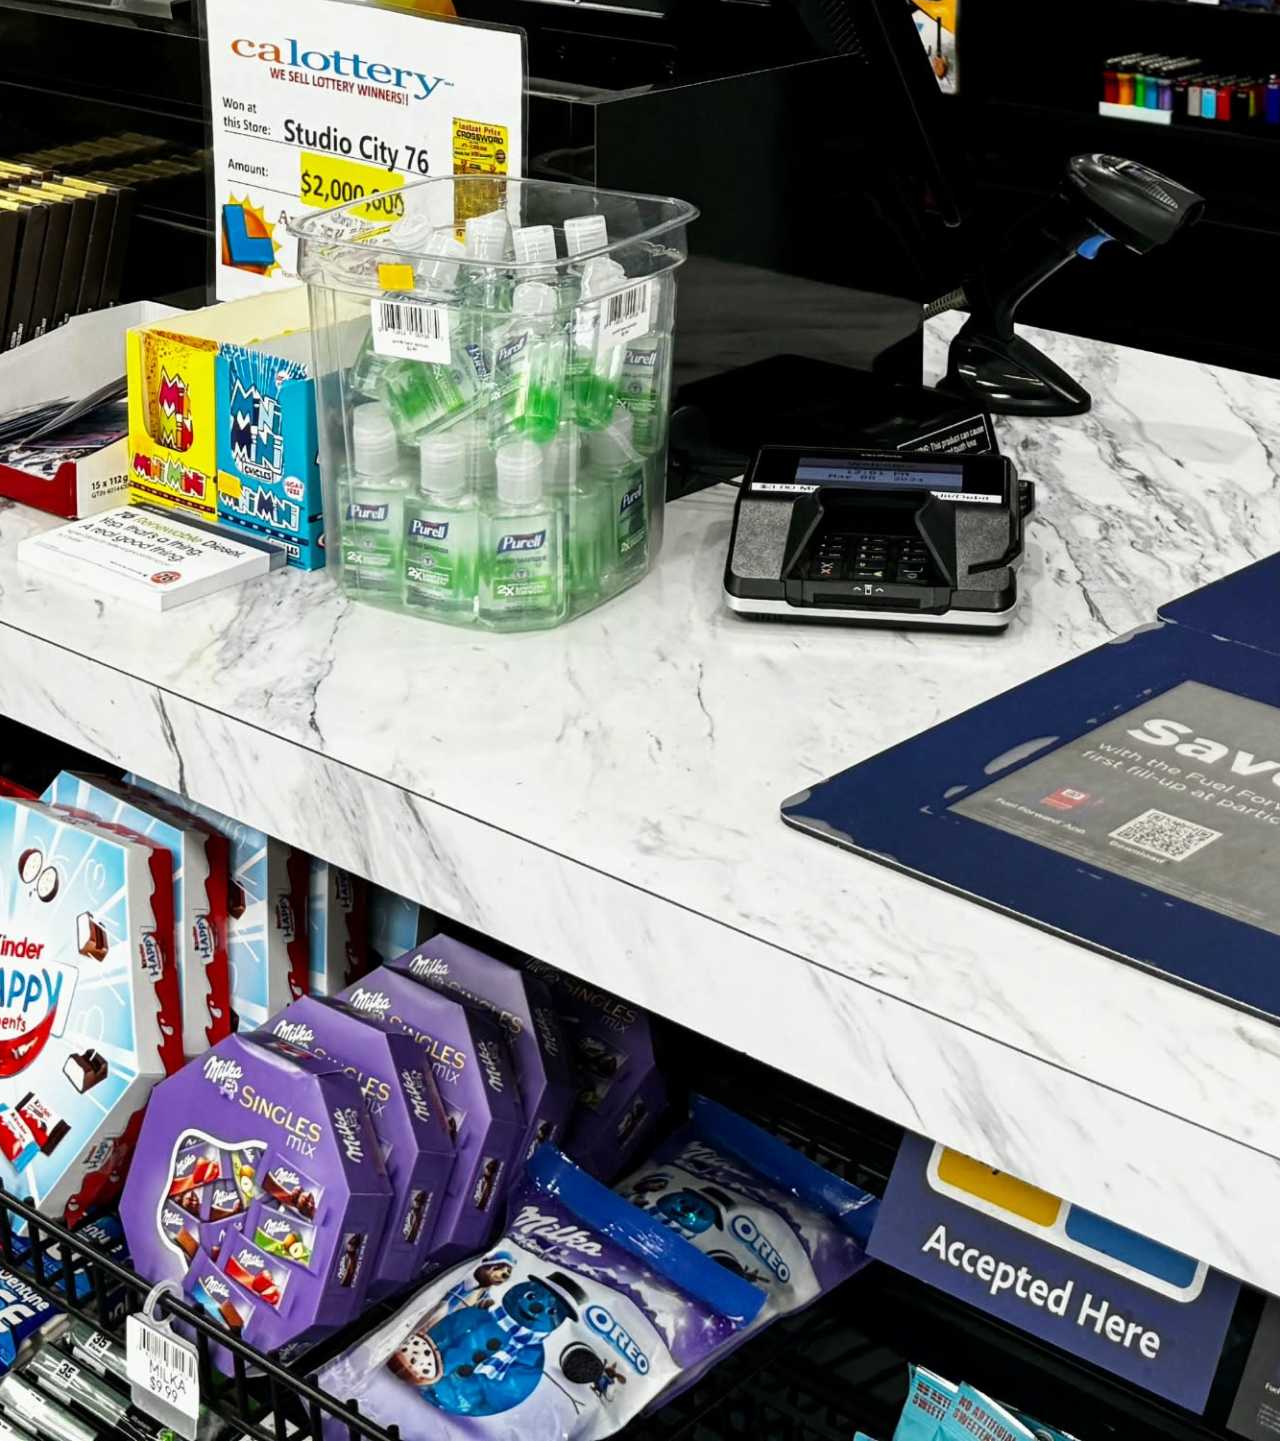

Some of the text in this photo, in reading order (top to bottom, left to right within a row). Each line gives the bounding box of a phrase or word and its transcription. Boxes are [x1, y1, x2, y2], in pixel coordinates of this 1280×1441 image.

[231, 37, 445, 100] calottery
[269, 67, 409, 106] WE SELL LOTTERY WINNERS!!
[222, 97, 257, 114] Won at
[223, 115, 271, 136] this Store:
[284, 119, 429, 174] Studio City 76
[227, 158, 269, 177] Amount:
[347, 502, 388, 521] Purell
[501, 535, 545, 553] Purell
[1082, 750, 1124, 769] first
[1126, 763, 1187, 793] fill-up
[1190, 785, 1218, 800] at
[1098, 742, 1142, 762] with
[1146, 756, 1181, 775] the
[1187, 768, 1235, 792] Fuel
[204, 1055, 244, 1086] Milka
[239, 1086, 321, 1141] SINGLES
[286, 1133, 316, 1160] mix
[922, 1225, 1161, 1360] Accepted Here
[585, 1306, 651, 1376] OREO
[147, 1361, 188, 1394] MILKA
